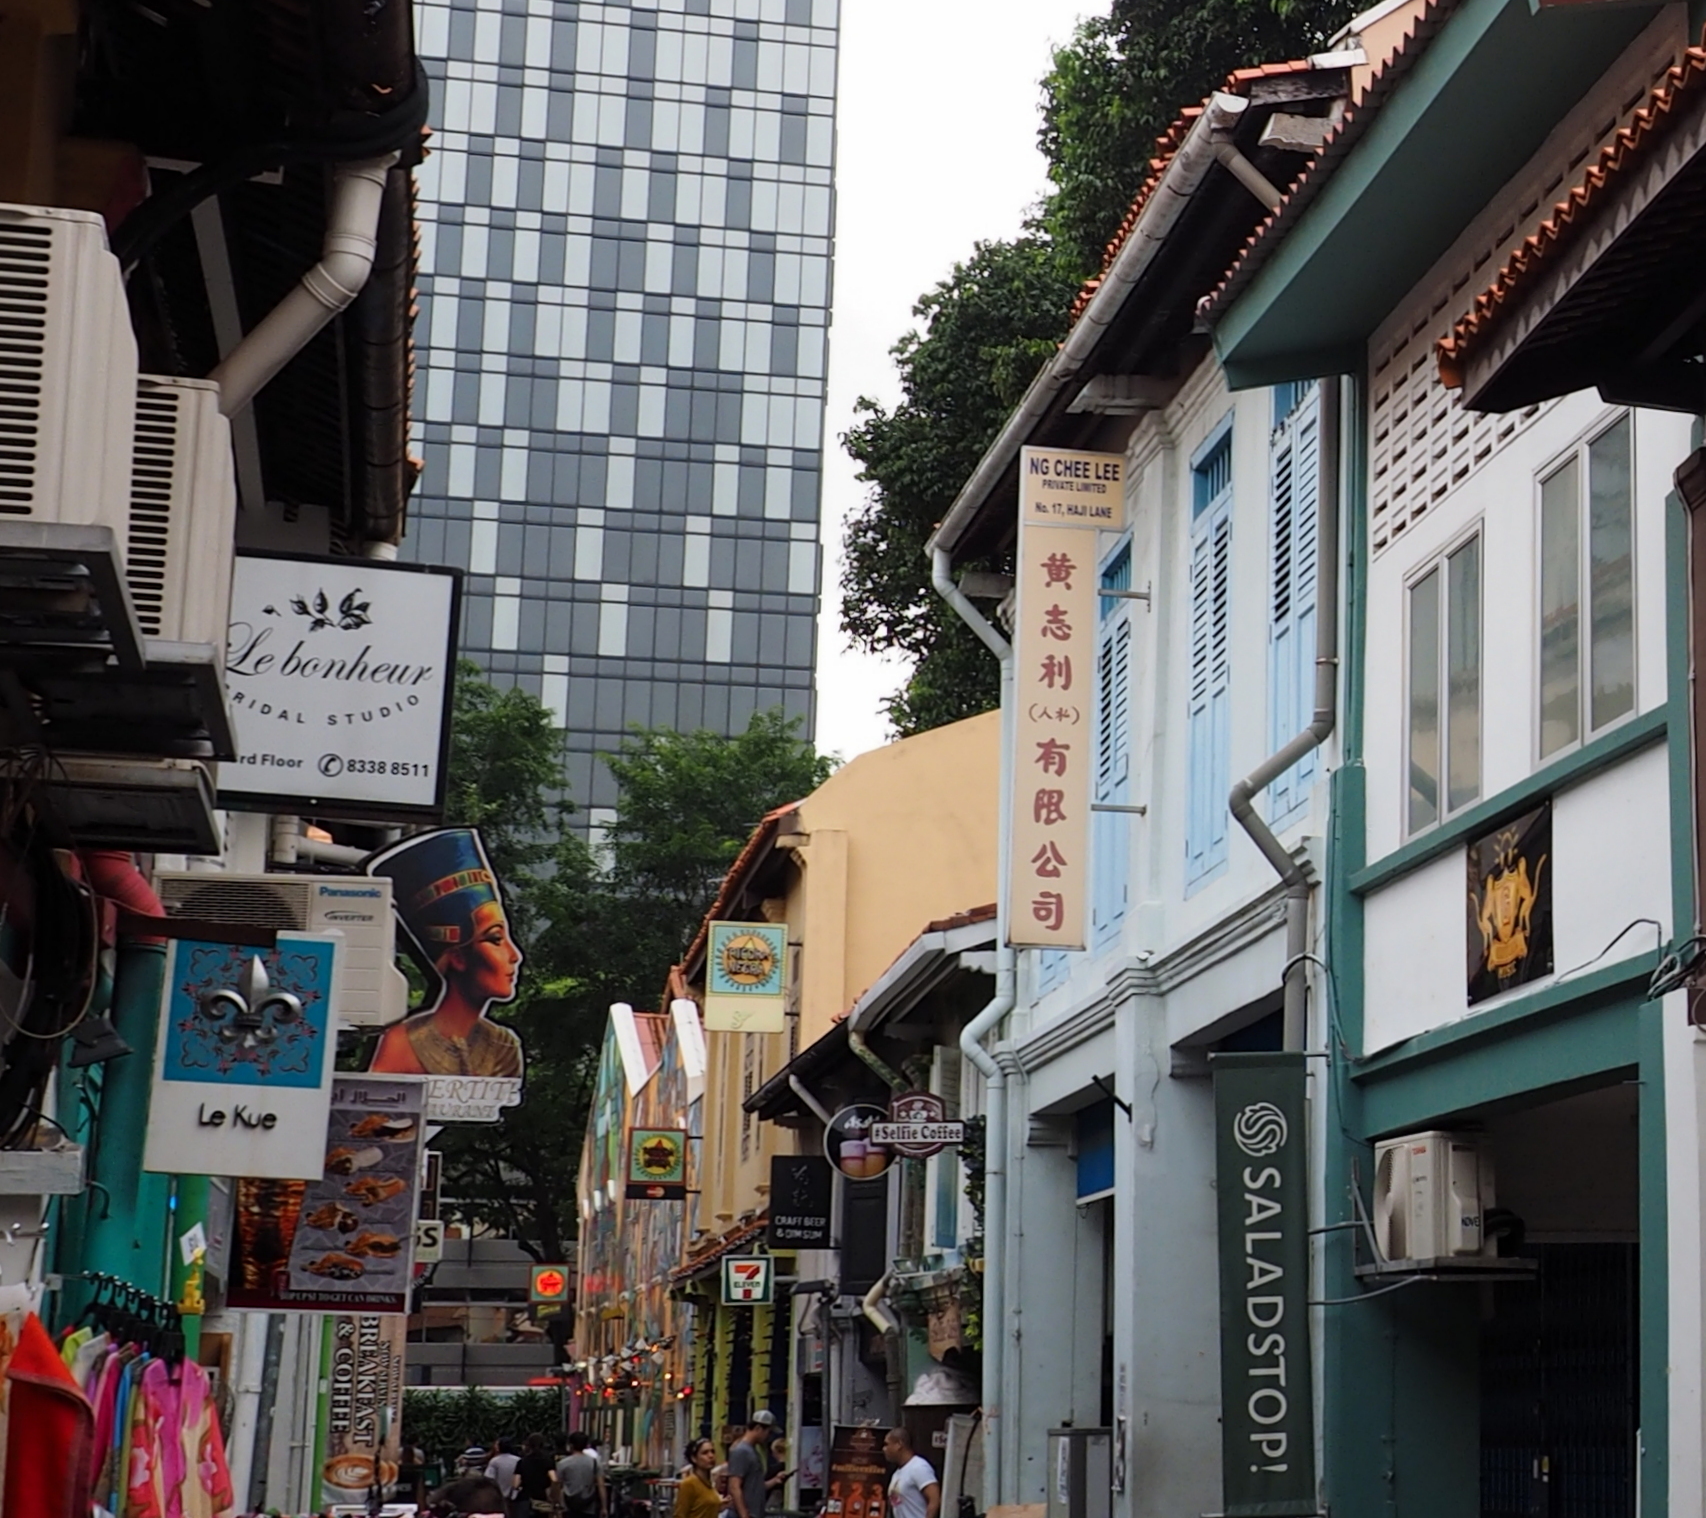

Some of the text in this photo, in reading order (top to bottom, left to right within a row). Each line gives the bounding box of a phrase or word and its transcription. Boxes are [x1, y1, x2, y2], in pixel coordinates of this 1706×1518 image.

[1030, 457, 1120, 481] NG CHEE LEE
[1042, 479, 1107, 494] PRIVATE LIMITED
[1067, 504, 1088, 516] HAJI
[1090, 506, 1112, 519] LANE
[226, 622, 434, 685] Le bonheur
[225, 683, 419, 726] RIDAL STUDIO
[238, 753, 429, 777] rd Floor 8338 8511
[319, 886, 382, 898] Panasonic
[199, 1103, 277, 1130] Le Kue
[874, 1125, 961, 1141] #Selfie Coffee
[775, 1215, 826, 1226] CRAFT BEER
[1243, 1166, 1288, 1473] SALADSTOP!
[331, 1347, 354, 1433] COFFEE
[353, 1315, 380, 1448] BREAKFAST
